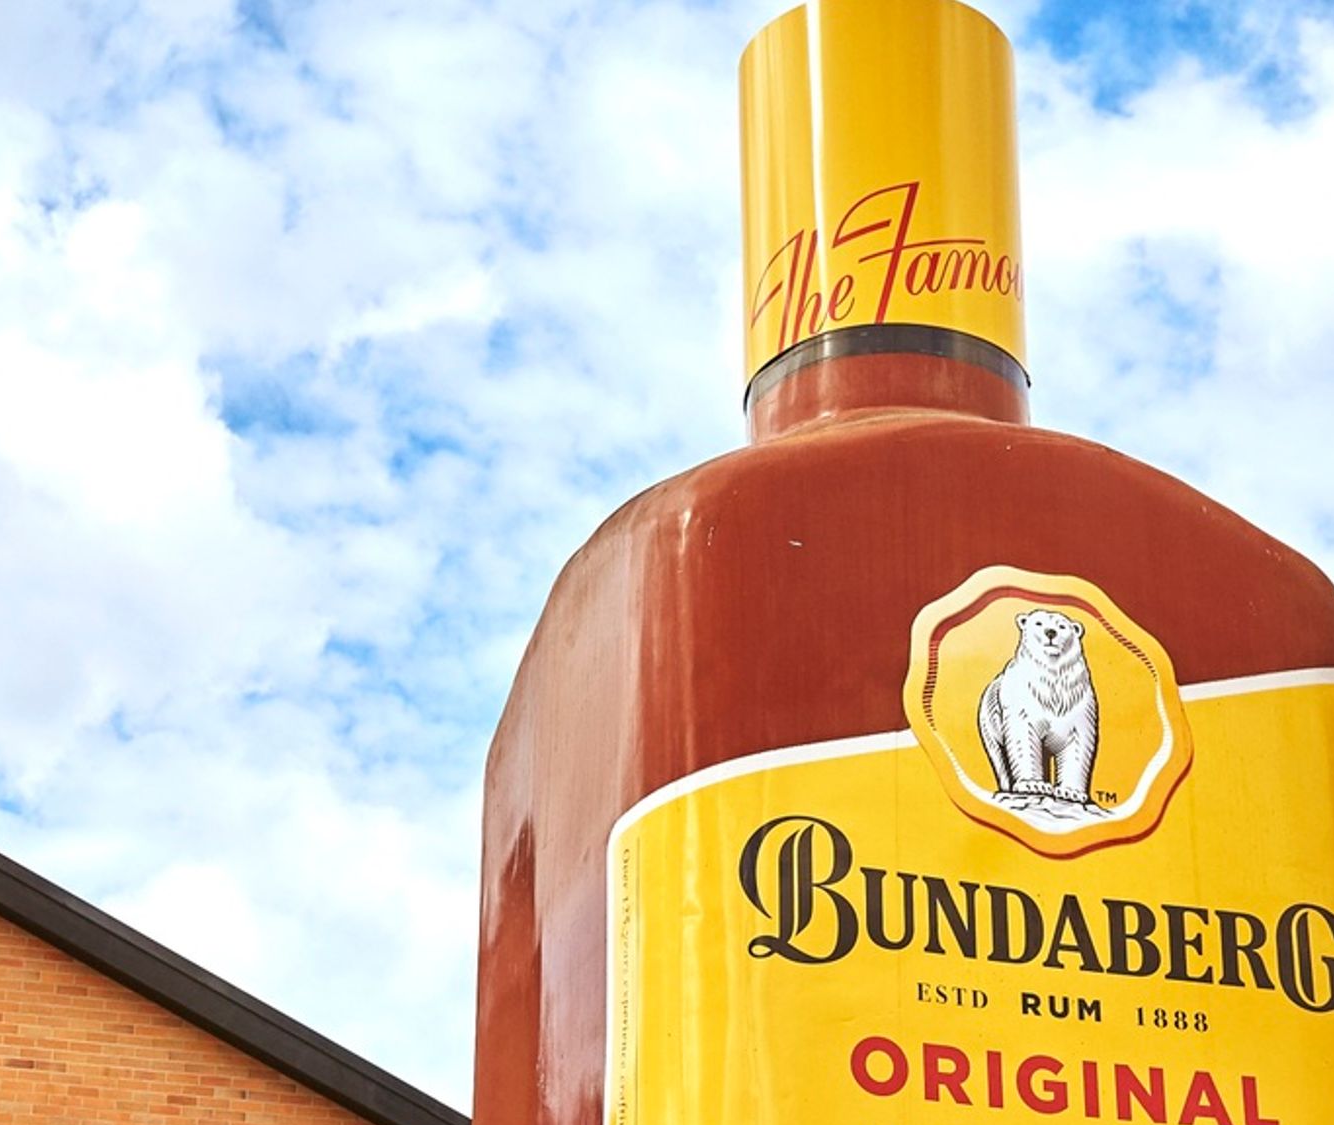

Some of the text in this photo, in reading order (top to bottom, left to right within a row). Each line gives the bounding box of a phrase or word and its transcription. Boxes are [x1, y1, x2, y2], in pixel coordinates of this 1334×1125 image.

[750, 229, 855, 353] The
[917, 982, 1210, 1033] ESTD RUM 1888
